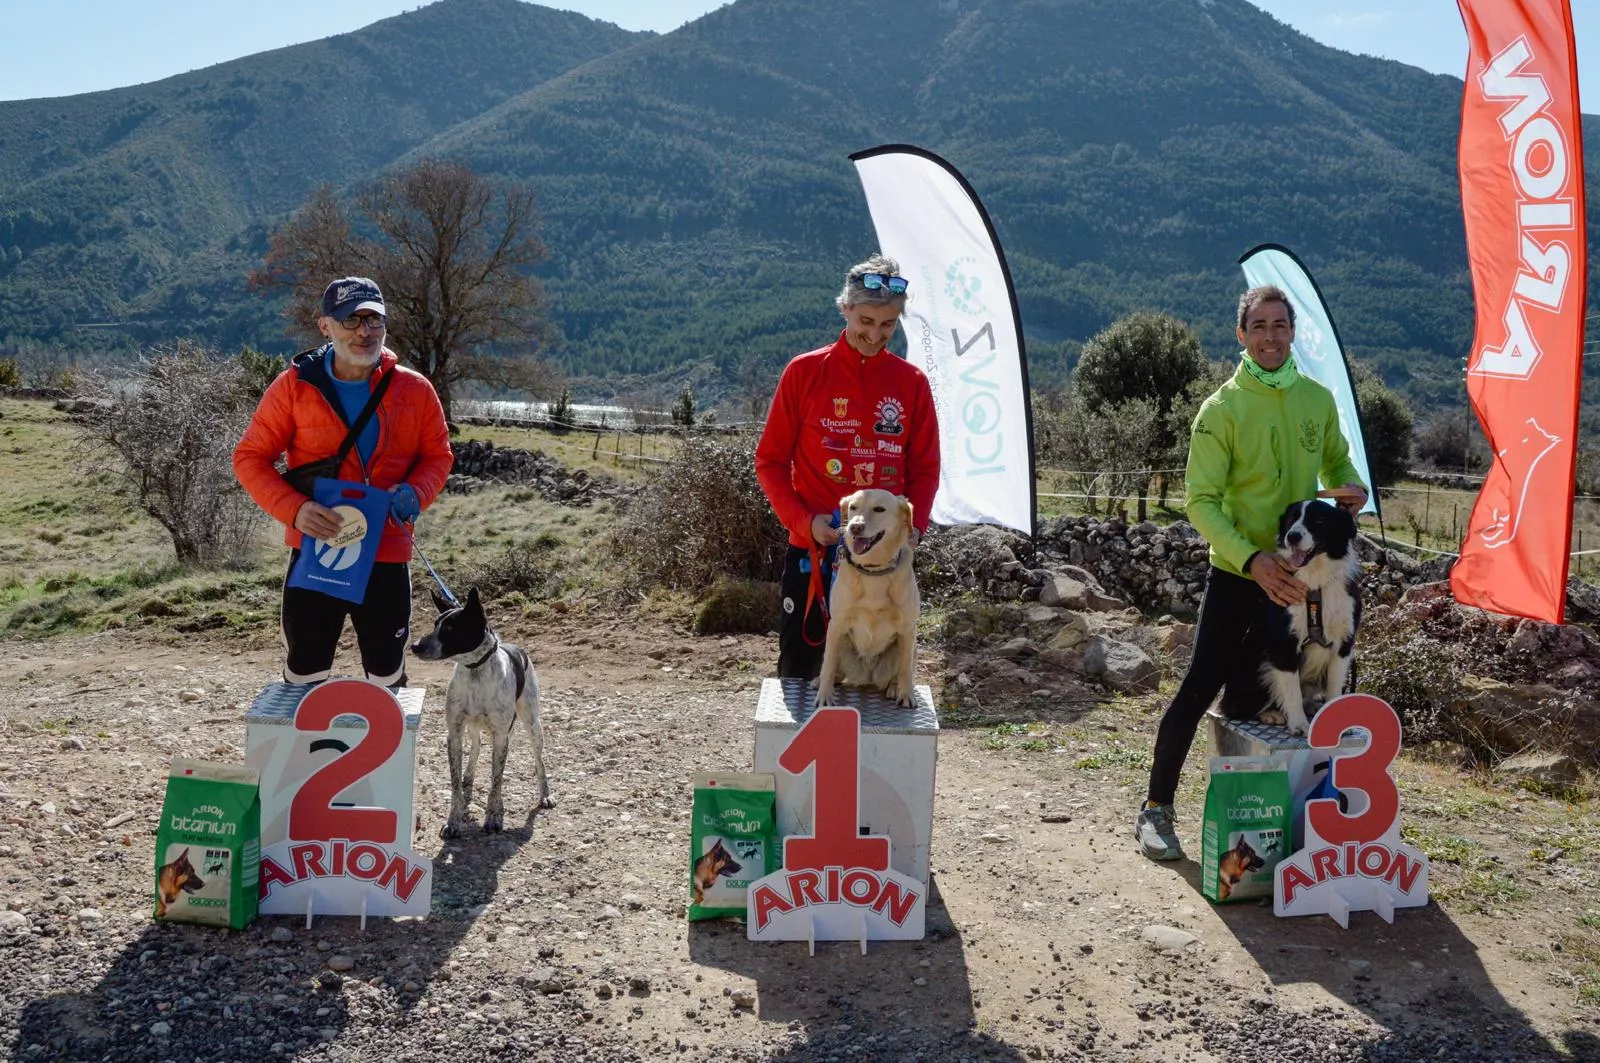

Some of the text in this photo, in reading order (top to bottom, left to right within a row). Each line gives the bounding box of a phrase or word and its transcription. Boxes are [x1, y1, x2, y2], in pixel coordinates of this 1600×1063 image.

[289, 677, 404, 843] 2
[779, 708, 888, 871] 1
[1308, 693, 1401, 848] 3
[171, 814, 237, 836] titanium
[1226, 805, 1284, 820] titanium
[259, 839, 427, 904] ARION
[753, 865, 920, 934] ARION
[1280, 841, 1424, 910] ARION
